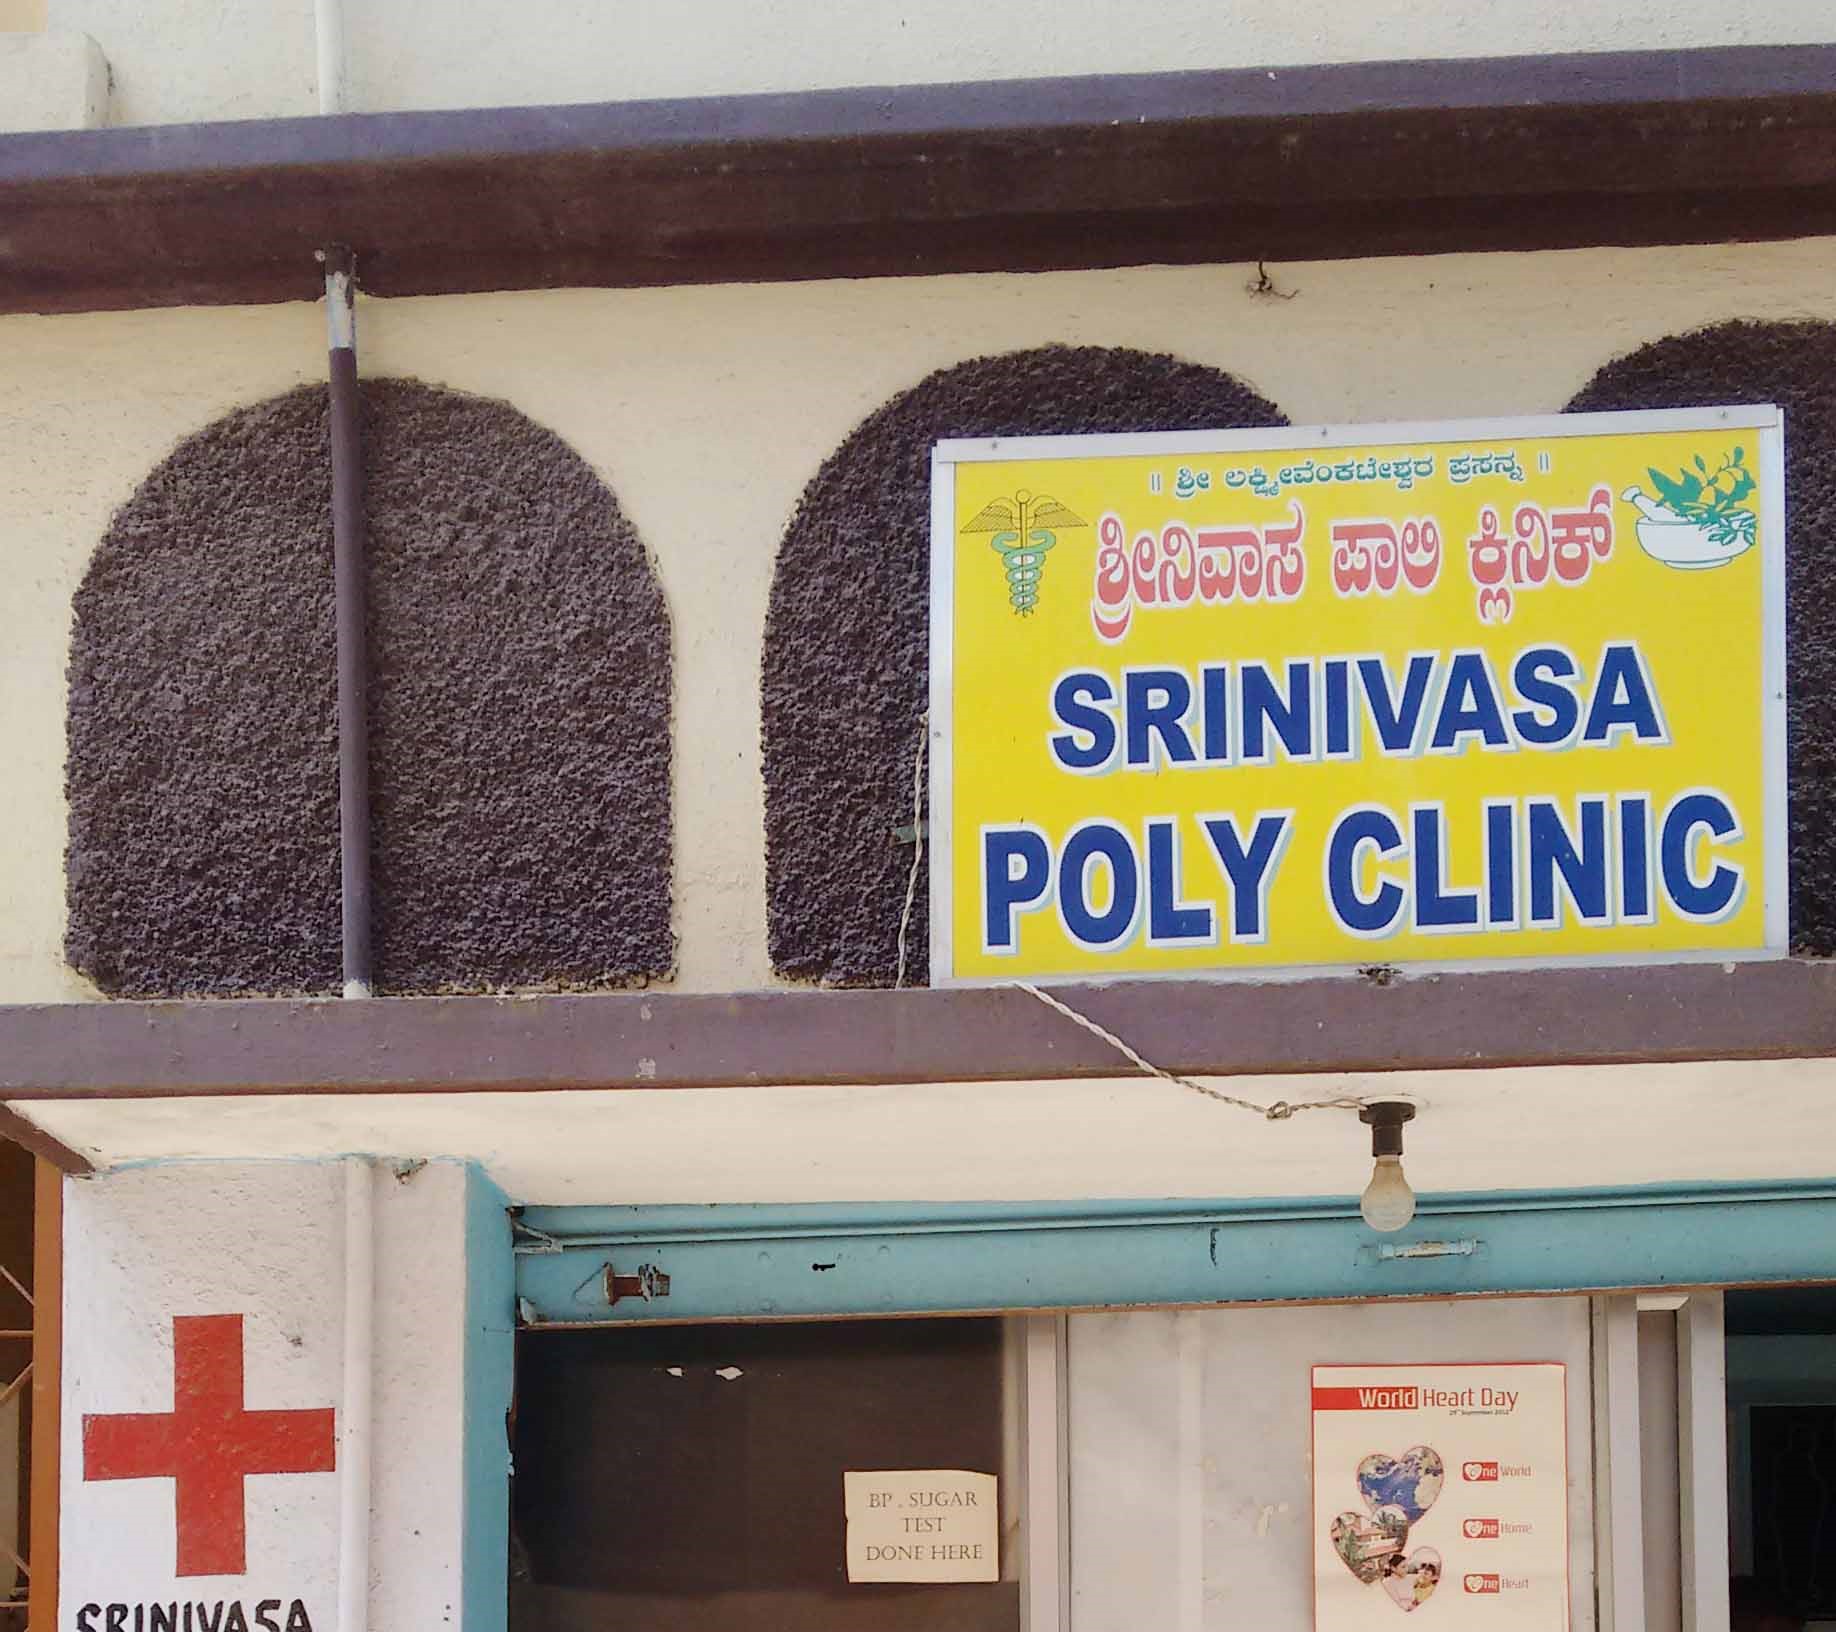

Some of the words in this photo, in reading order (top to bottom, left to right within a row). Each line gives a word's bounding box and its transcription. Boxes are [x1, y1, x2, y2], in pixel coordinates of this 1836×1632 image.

[1176, 466, 1210, 497] ಶ್ರೀ
[1449, 451, 1524, 483] ಪ್ರಸನ್ನ
[1093, 502, 1304, 639] ಶ್ರೀನಿವಾಸ
[1331, 515, 1440, 593] ಪಾಲಿ
[1469, 487, 1612, 622] ಕ್ಲಿನಿಕ್
[1050, 646, 1662, 766] SRINIVASA
[983, 814, 1288, 947] POLY
[1328, 793, 1739, 934] CLINIC
[1358, 1388, 1417, 1408] World
[1423, 1388, 1475, 1407] Heart
[1481, 1387, 1520, 1411] Day
[1501, 1464, 1532, 1477] World
[868, 1492, 892, 1508] BP
[909, 1491, 978, 1507] SUGAR
[901, 1516, 947, 1533] TEST
[866, 1545, 924, 1561] DONE
[931, 1544, 984, 1560] HERE
